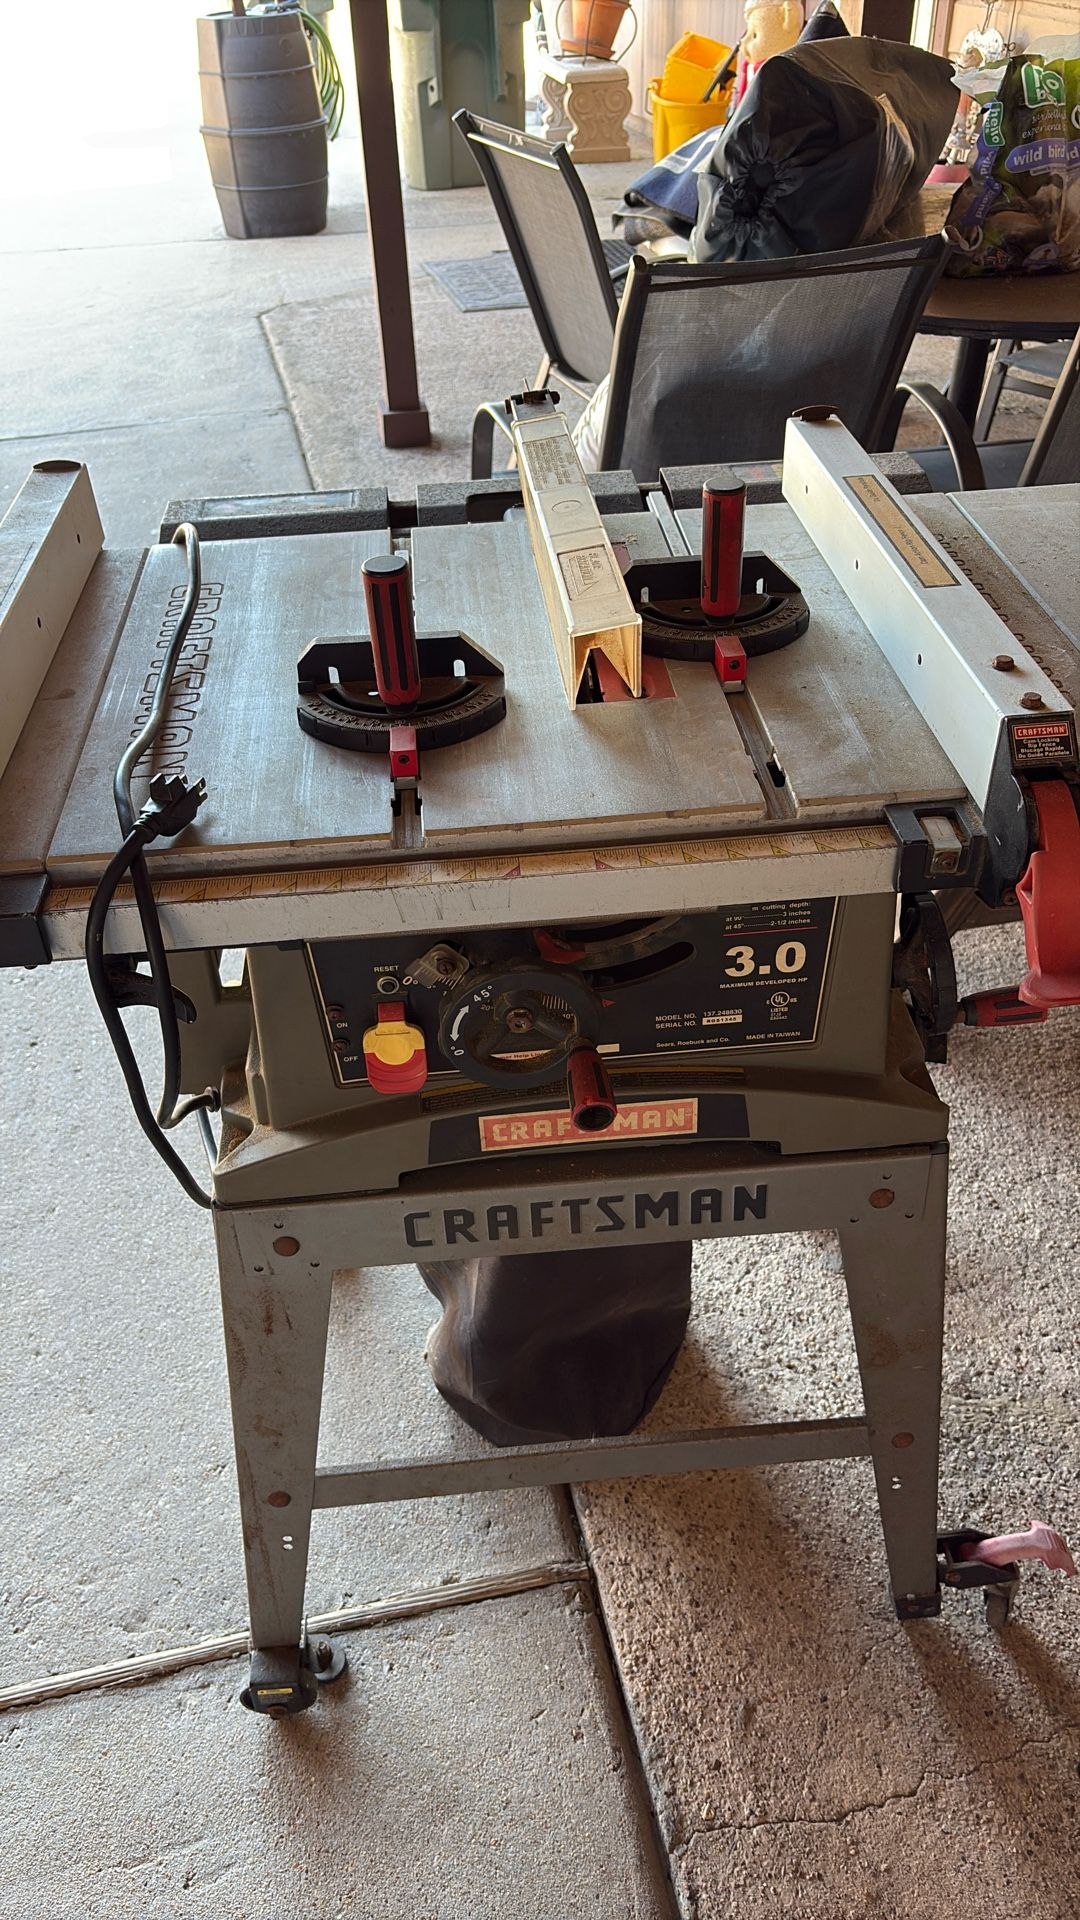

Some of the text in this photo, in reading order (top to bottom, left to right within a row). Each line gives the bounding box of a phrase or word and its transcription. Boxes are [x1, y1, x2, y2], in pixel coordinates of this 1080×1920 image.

[990, 106, 1000, 143] hello
[1014, 146, 1042, 166] wild
[1048, 144, 1065, 158] bird
[1018, 726, 1064, 736] CRAFTSMAN
[724, 941, 806, 978] 3.0
[402, 976, 418, 986] 0°
[473, 985, 492, 1002] 45°
[492, 1106, 686, 1142] CRAFMAN
[404, 1184, 768, 1248] CRAFTSMAN
